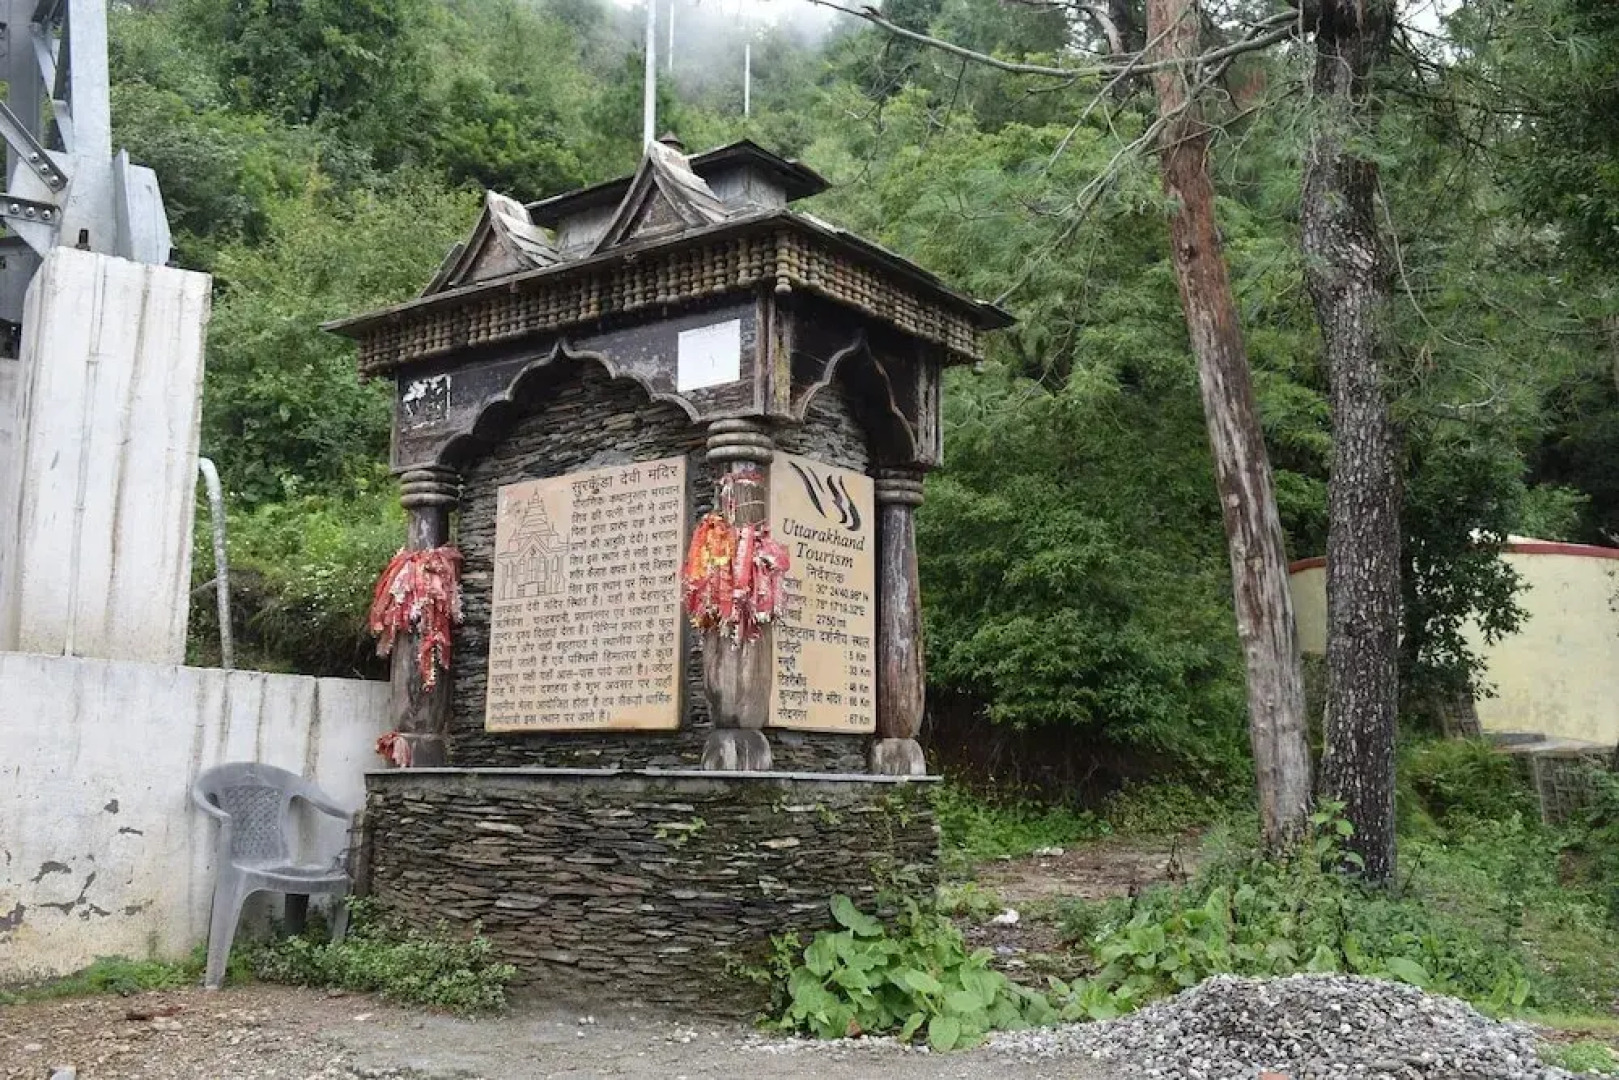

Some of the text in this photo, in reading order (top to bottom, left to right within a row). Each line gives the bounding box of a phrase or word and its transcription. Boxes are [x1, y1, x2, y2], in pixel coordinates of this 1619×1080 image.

[619, 467, 640, 485] देवी
[647, 461, 677, 482] मंदिर
[782, 517, 865, 551] Uttarakhand
[796, 541, 853, 568] Tourism
